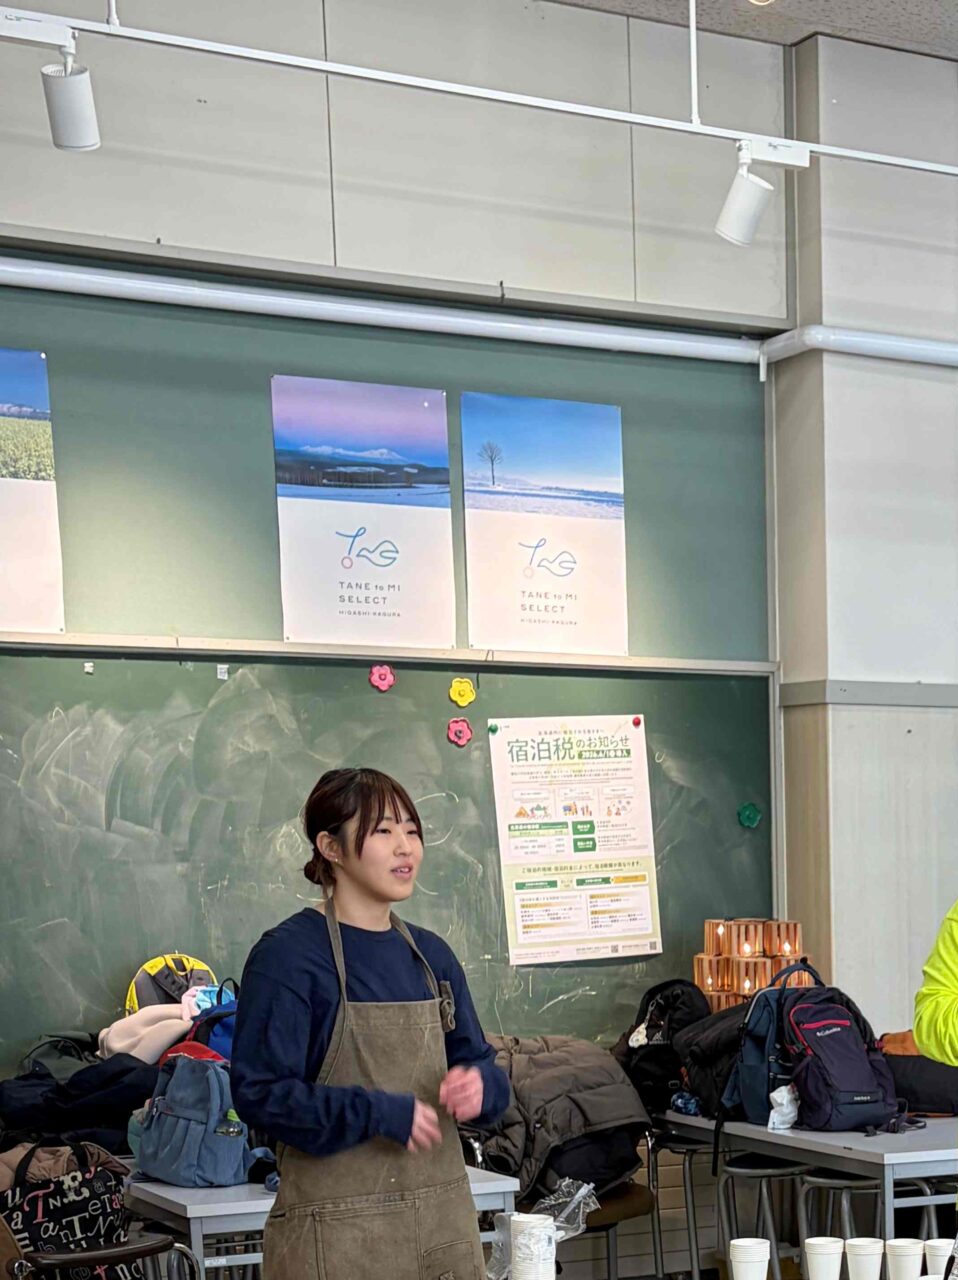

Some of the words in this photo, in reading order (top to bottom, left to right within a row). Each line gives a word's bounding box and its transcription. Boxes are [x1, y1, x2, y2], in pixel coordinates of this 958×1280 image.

[339, 581, 370, 590] TANE
[387, 584, 400, 592] MI
[339, 595, 387, 604] SELECT
[521, 591, 550, 599] TANE
[521, 604, 565, 613] SELECT
